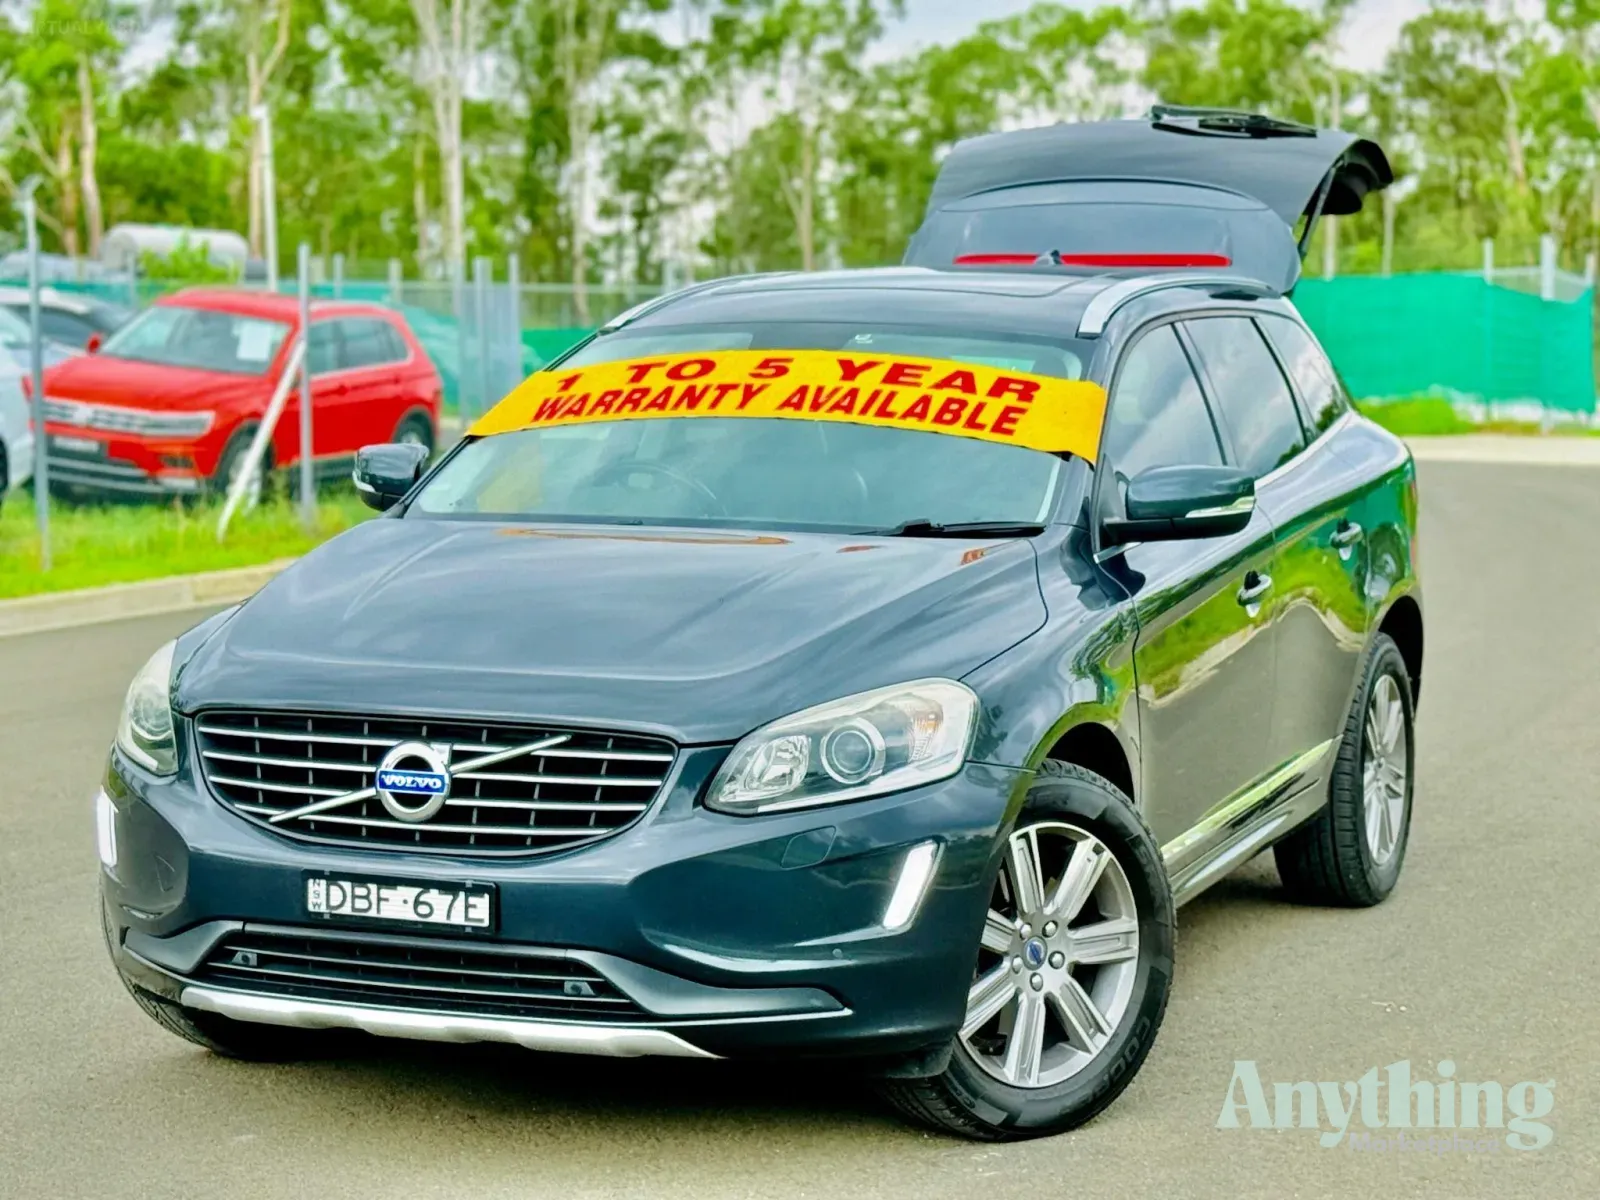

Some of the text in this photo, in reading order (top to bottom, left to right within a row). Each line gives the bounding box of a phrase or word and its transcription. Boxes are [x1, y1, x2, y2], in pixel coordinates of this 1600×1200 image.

[557, 358, 1041, 403] 1 TO 5 YEAR
[530, 383, 1028, 436] WARRANTY AVAILABLE
[381, 775, 442, 789] VOLVO
